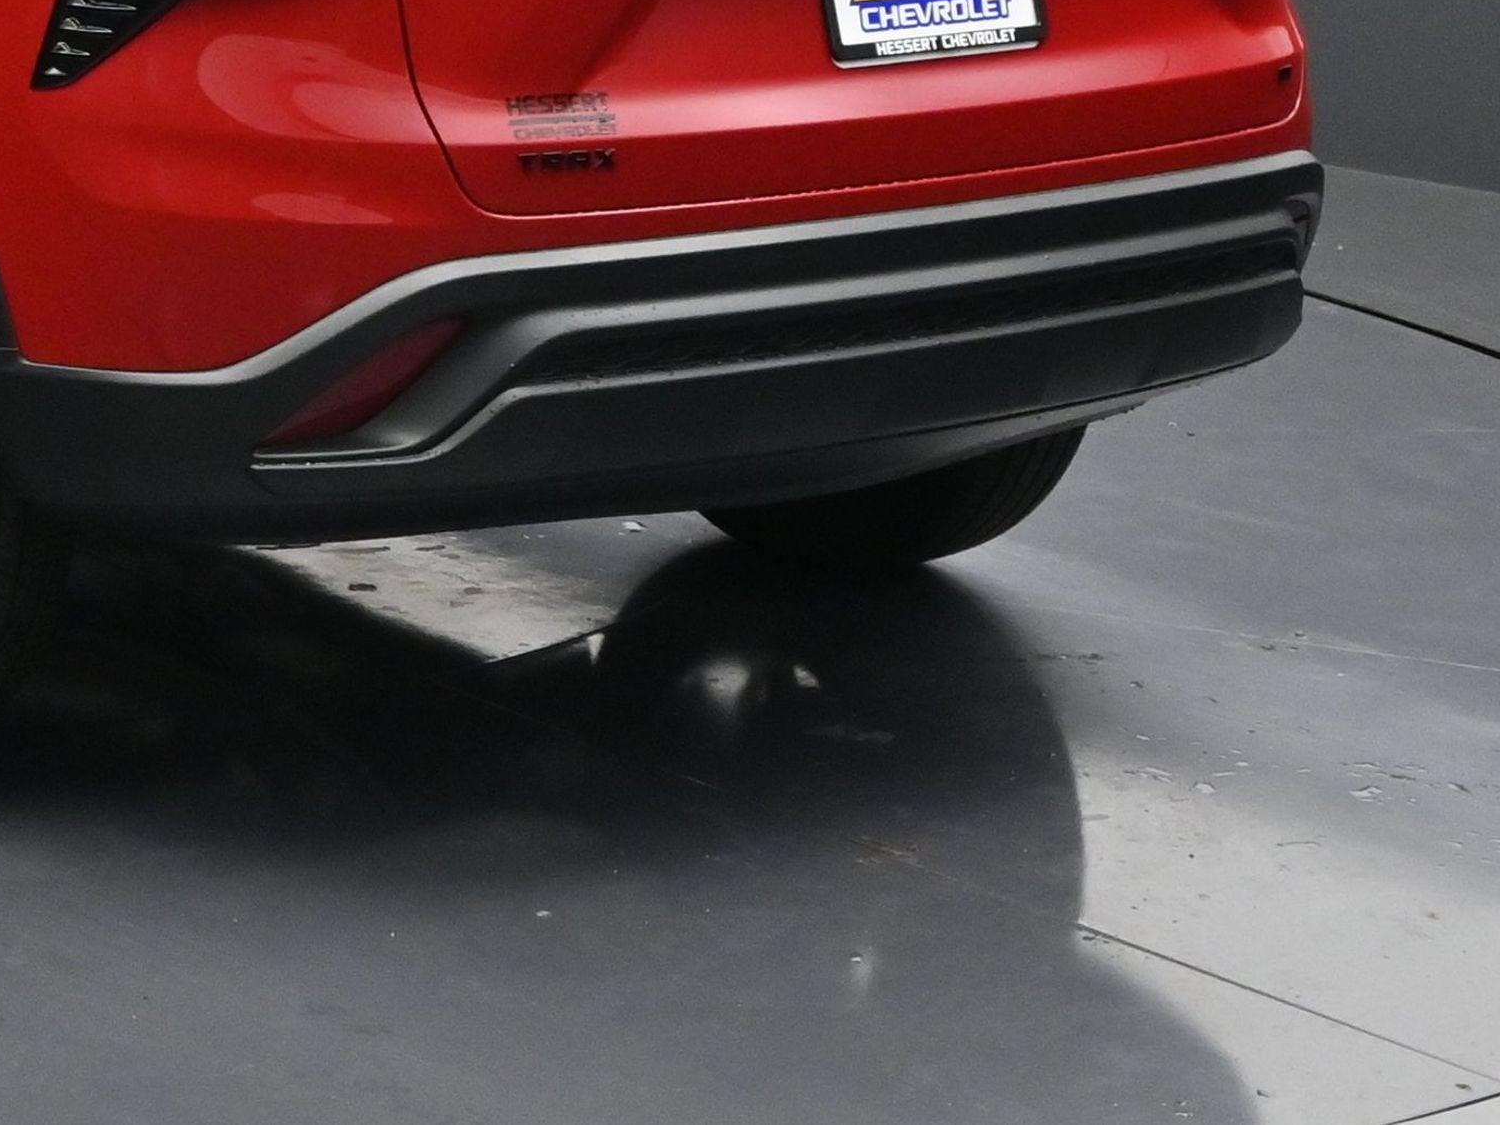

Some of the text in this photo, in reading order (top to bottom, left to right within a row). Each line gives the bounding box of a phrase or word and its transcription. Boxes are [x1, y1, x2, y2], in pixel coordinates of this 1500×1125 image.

[876, 29, 1016, 56] HESSERT CHEVROLET
[506, 92, 608, 116] HESSERT
[518, 148, 616, 173] TRAX
